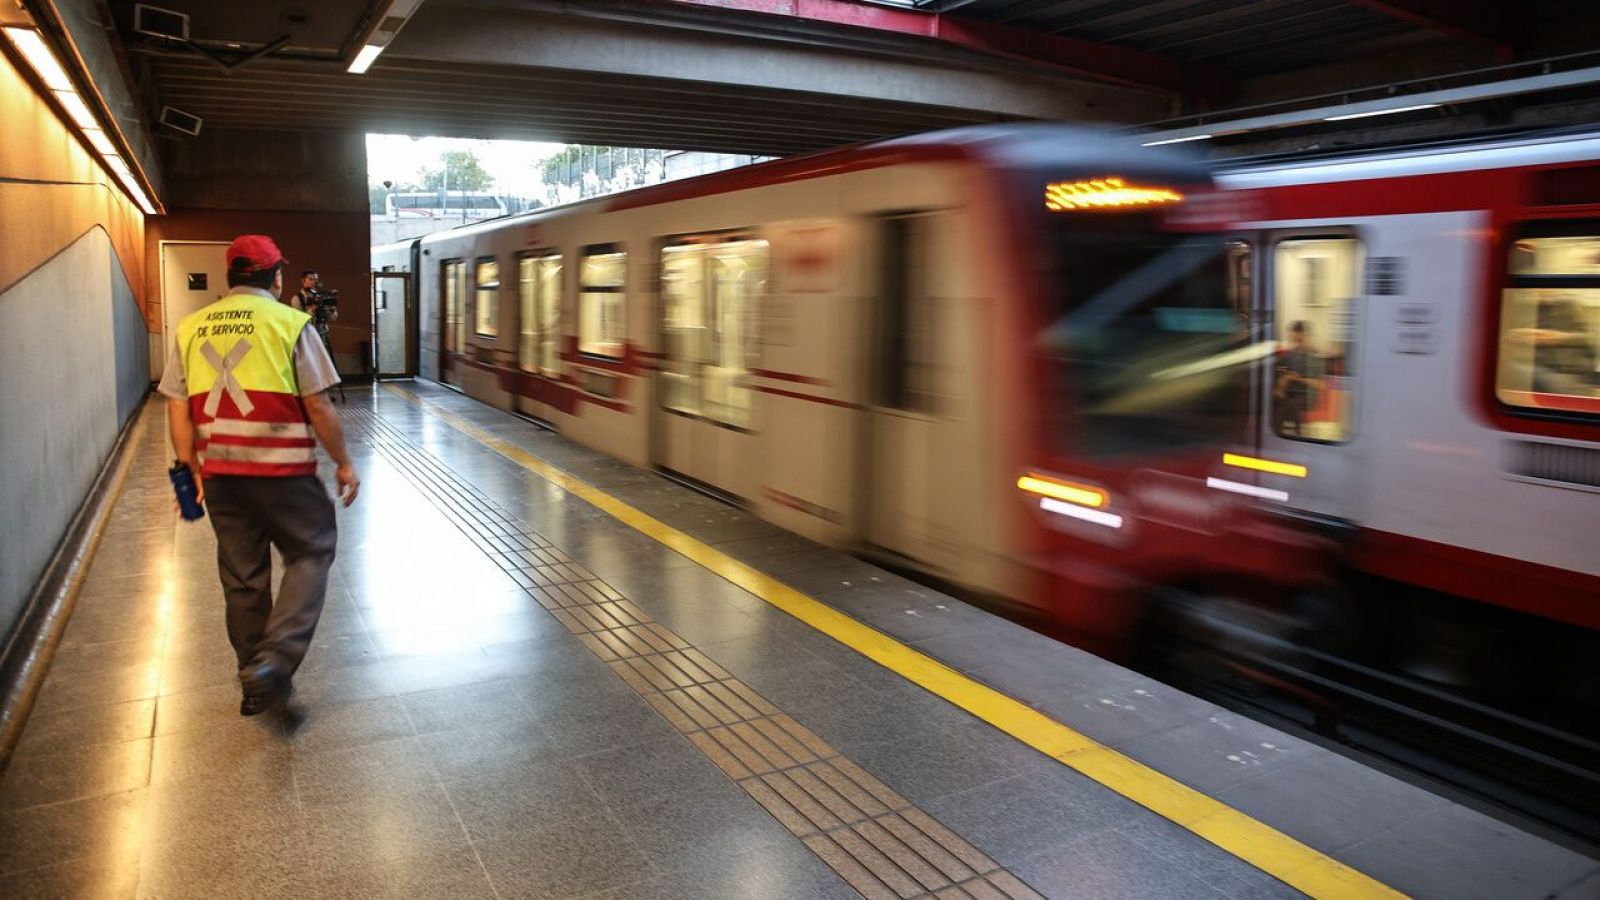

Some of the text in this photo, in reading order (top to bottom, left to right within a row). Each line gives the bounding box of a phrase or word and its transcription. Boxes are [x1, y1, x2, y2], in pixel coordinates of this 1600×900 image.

[205, 310, 255, 321] ASISTENTE
[197, 323, 255, 338] DE SERVICIO
